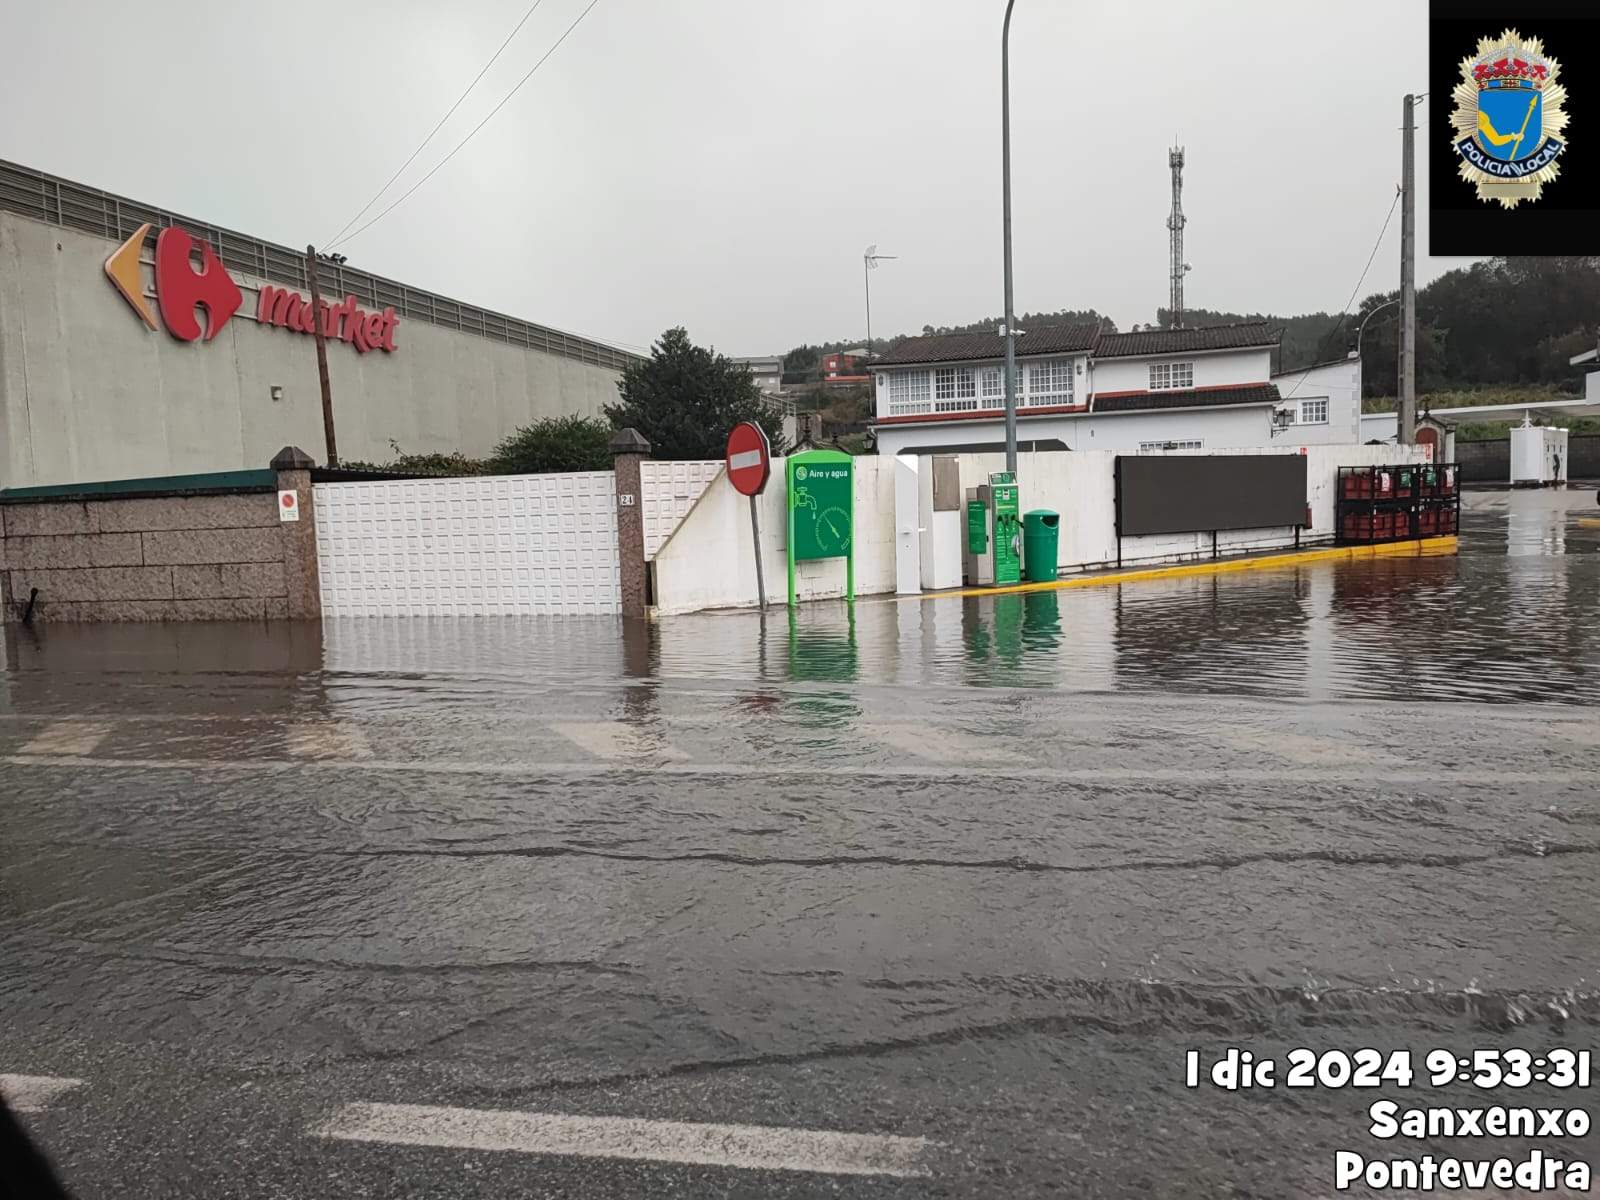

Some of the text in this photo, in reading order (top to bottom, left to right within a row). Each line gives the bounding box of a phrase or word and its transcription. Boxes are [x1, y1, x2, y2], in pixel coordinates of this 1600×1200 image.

[256, 285, 400, 353] market
[809, 469, 824, 478] Aire
[830, 470, 848, 479] agua
[621, 495, 633, 505] 24
